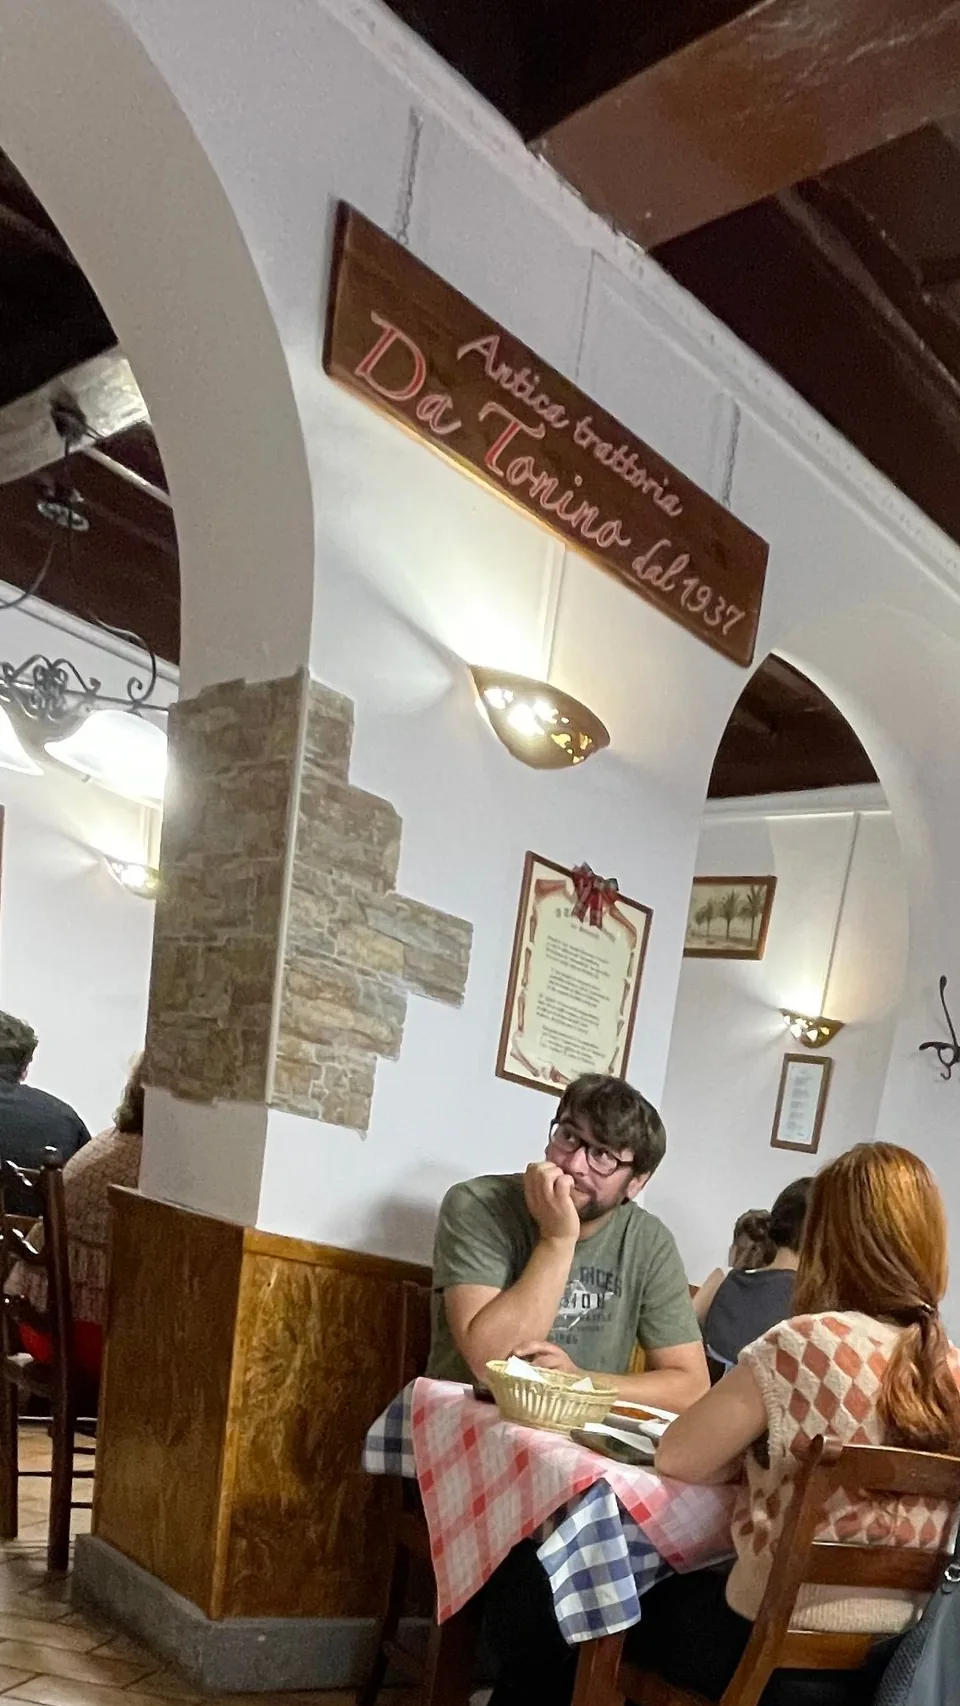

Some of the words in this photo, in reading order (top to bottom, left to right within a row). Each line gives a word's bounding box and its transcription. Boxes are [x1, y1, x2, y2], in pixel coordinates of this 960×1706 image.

[354, 310, 462, 435] Da
[478, 401, 631, 549] Tonino
[631, 539, 691, 593] dal
[682, 577, 746, 636] 1937
[456, 334, 571, 430] Antica
[572, 415, 683, 517] trattoria
